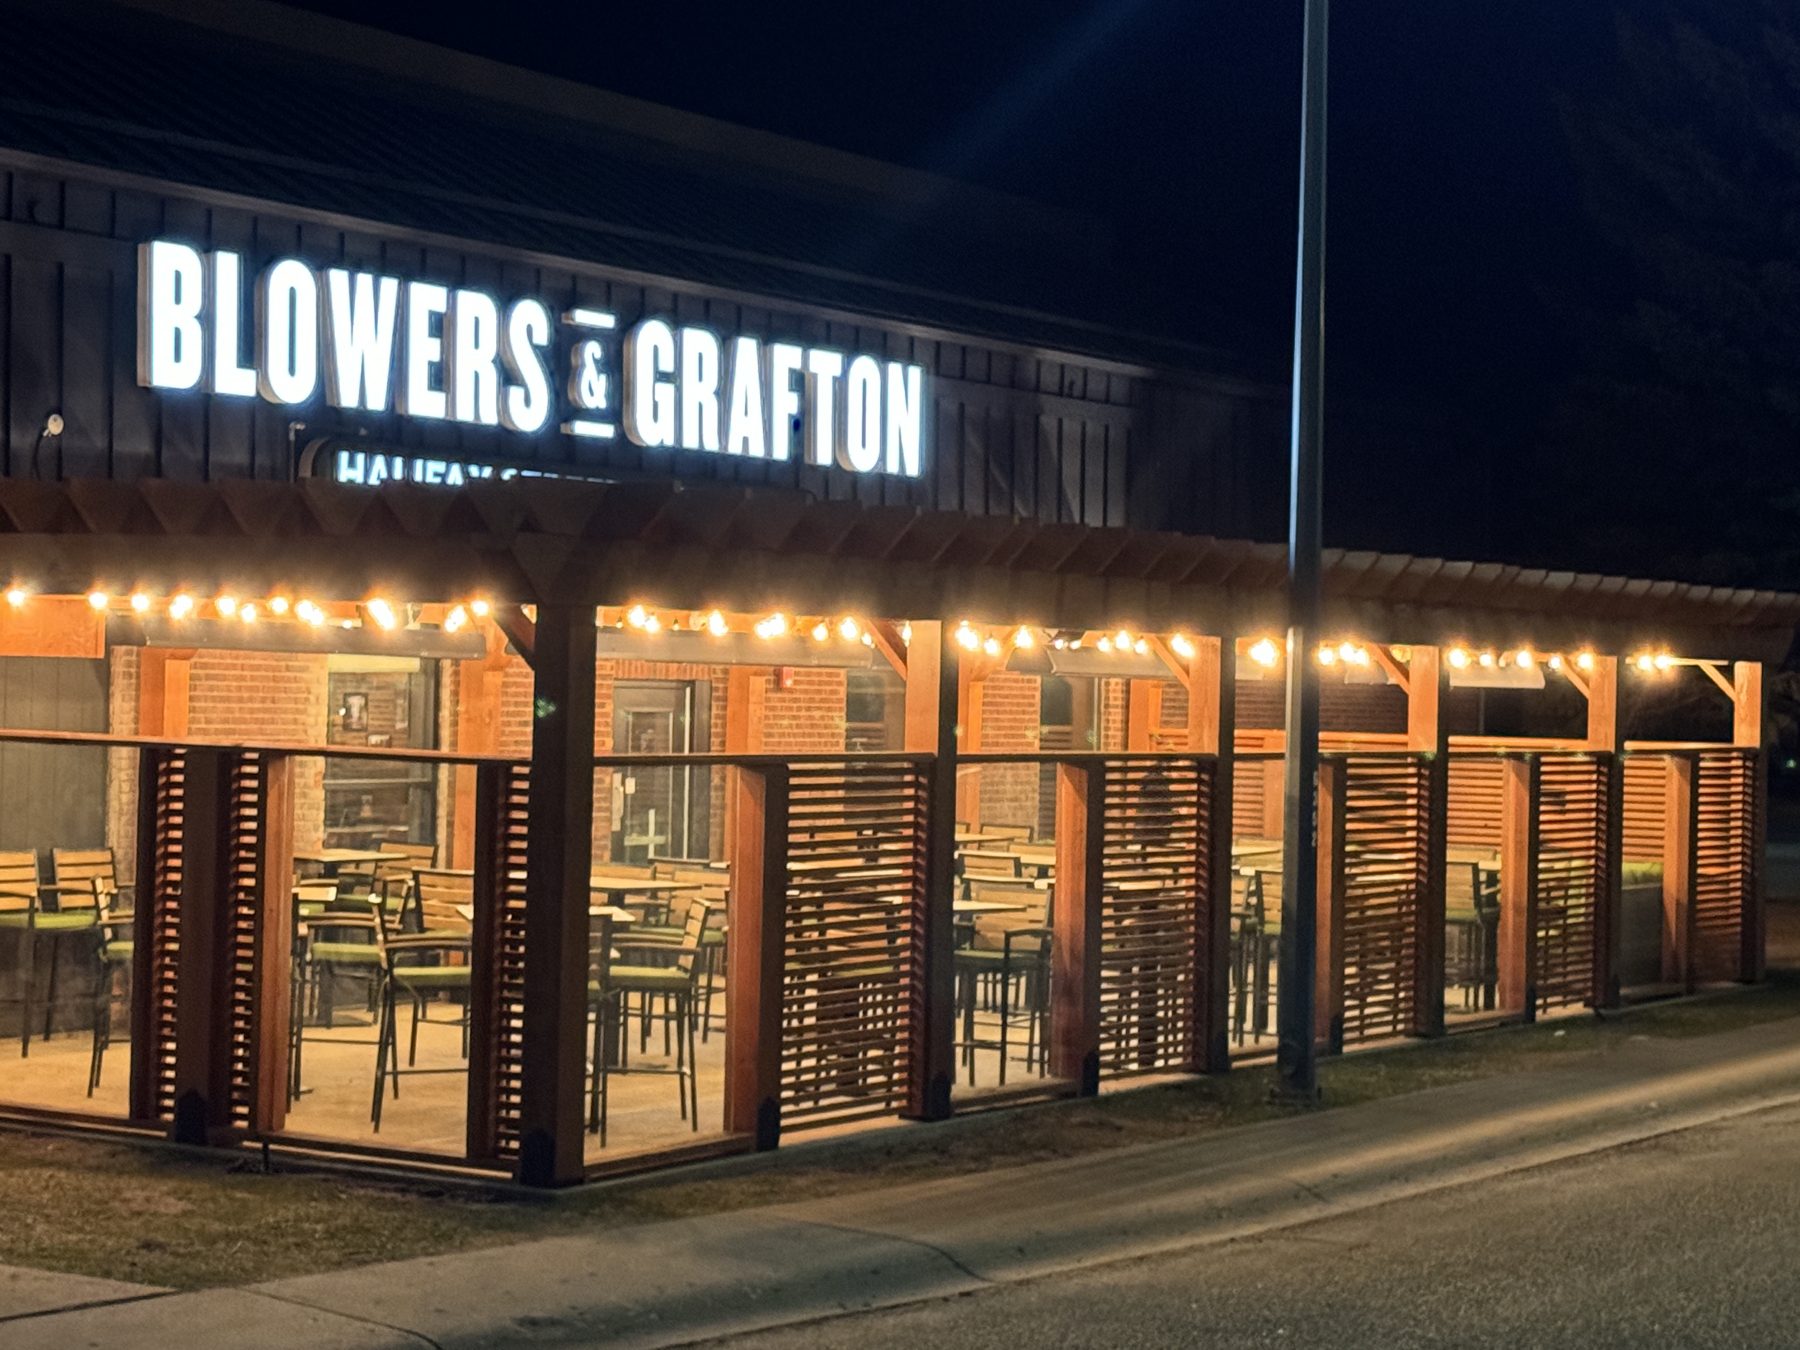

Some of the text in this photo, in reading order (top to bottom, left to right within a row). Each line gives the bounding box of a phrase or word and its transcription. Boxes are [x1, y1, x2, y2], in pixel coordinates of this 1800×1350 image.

[143, 240, 924, 479] BLOWERS & GRAFTON
